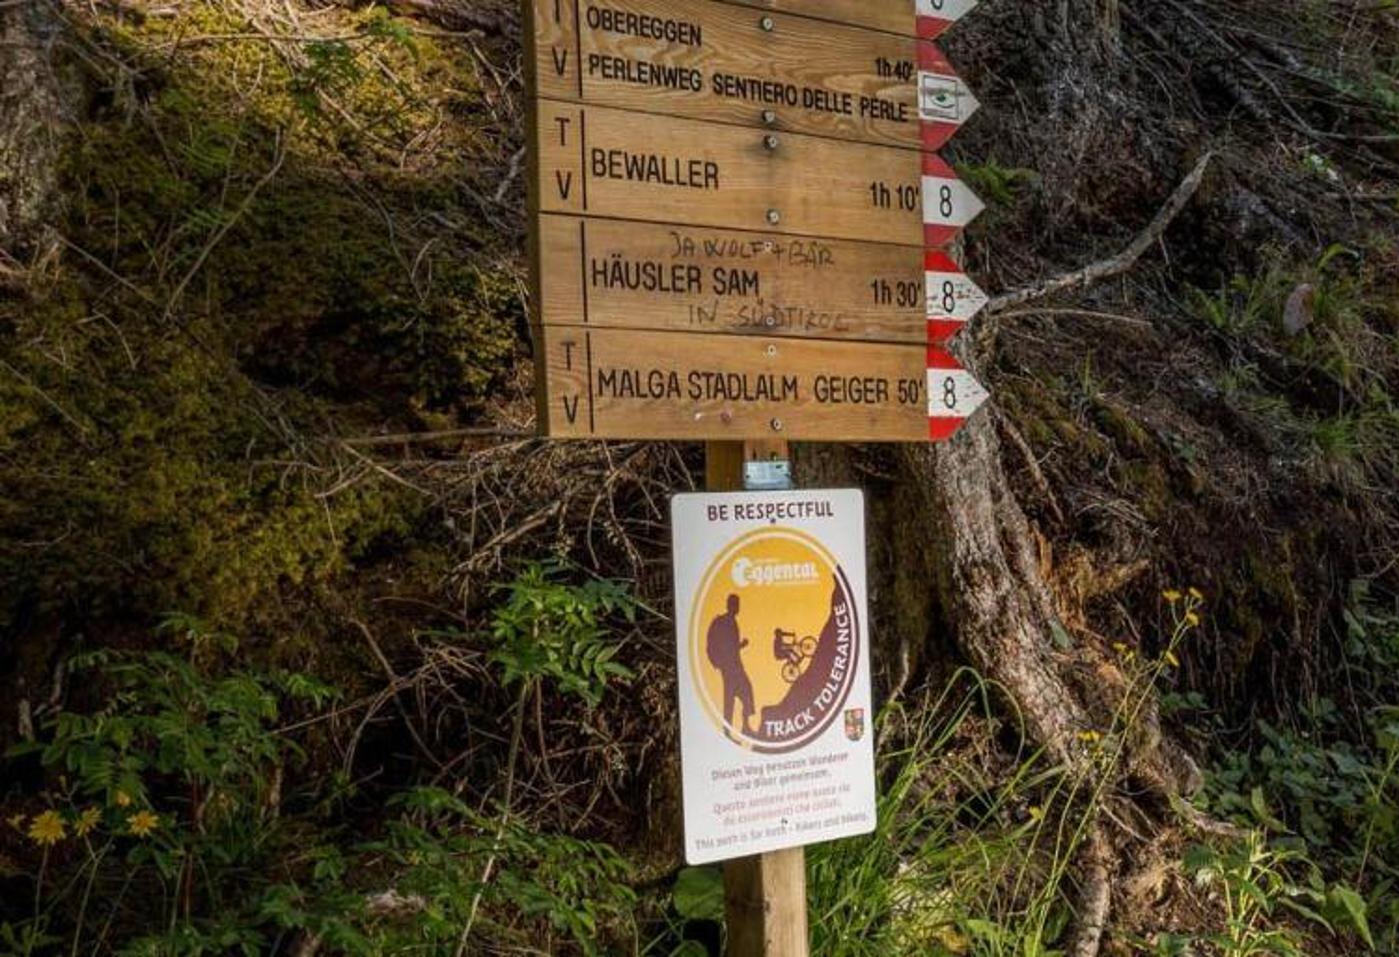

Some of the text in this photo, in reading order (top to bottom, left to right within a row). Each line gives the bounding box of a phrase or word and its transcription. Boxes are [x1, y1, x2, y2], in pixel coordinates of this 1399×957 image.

[587, 6, 702, 46] OBEREGGEN
[552, 46, 567, 76] V
[589, 54, 908, 122] PERLENWEG SENTIERO DELLE PERLE
[555, 117, 570, 147] T
[556, 170, 572, 200] V
[591, 148, 719, 190] BEWALLER
[870, 182, 891, 209] 1h
[940, 185, 952, 217] 8
[592, 253, 760, 297] HÄUSLER SAM
[871, 279, 892, 305] 1h
[943, 280, 955, 313] 8
[561, 341, 576, 371] T
[598, 368, 681, 399] MALGA
[688, 370, 798, 401] STADLALM
[814, 375, 889, 404] GEIGER
[944, 376, 956, 409] 8
[563, 395, 578, 425] V
[707, 501, 834, 521] BE RESPECTFUL
[764, 602, 849, 737] TRACK TOLERANCE
